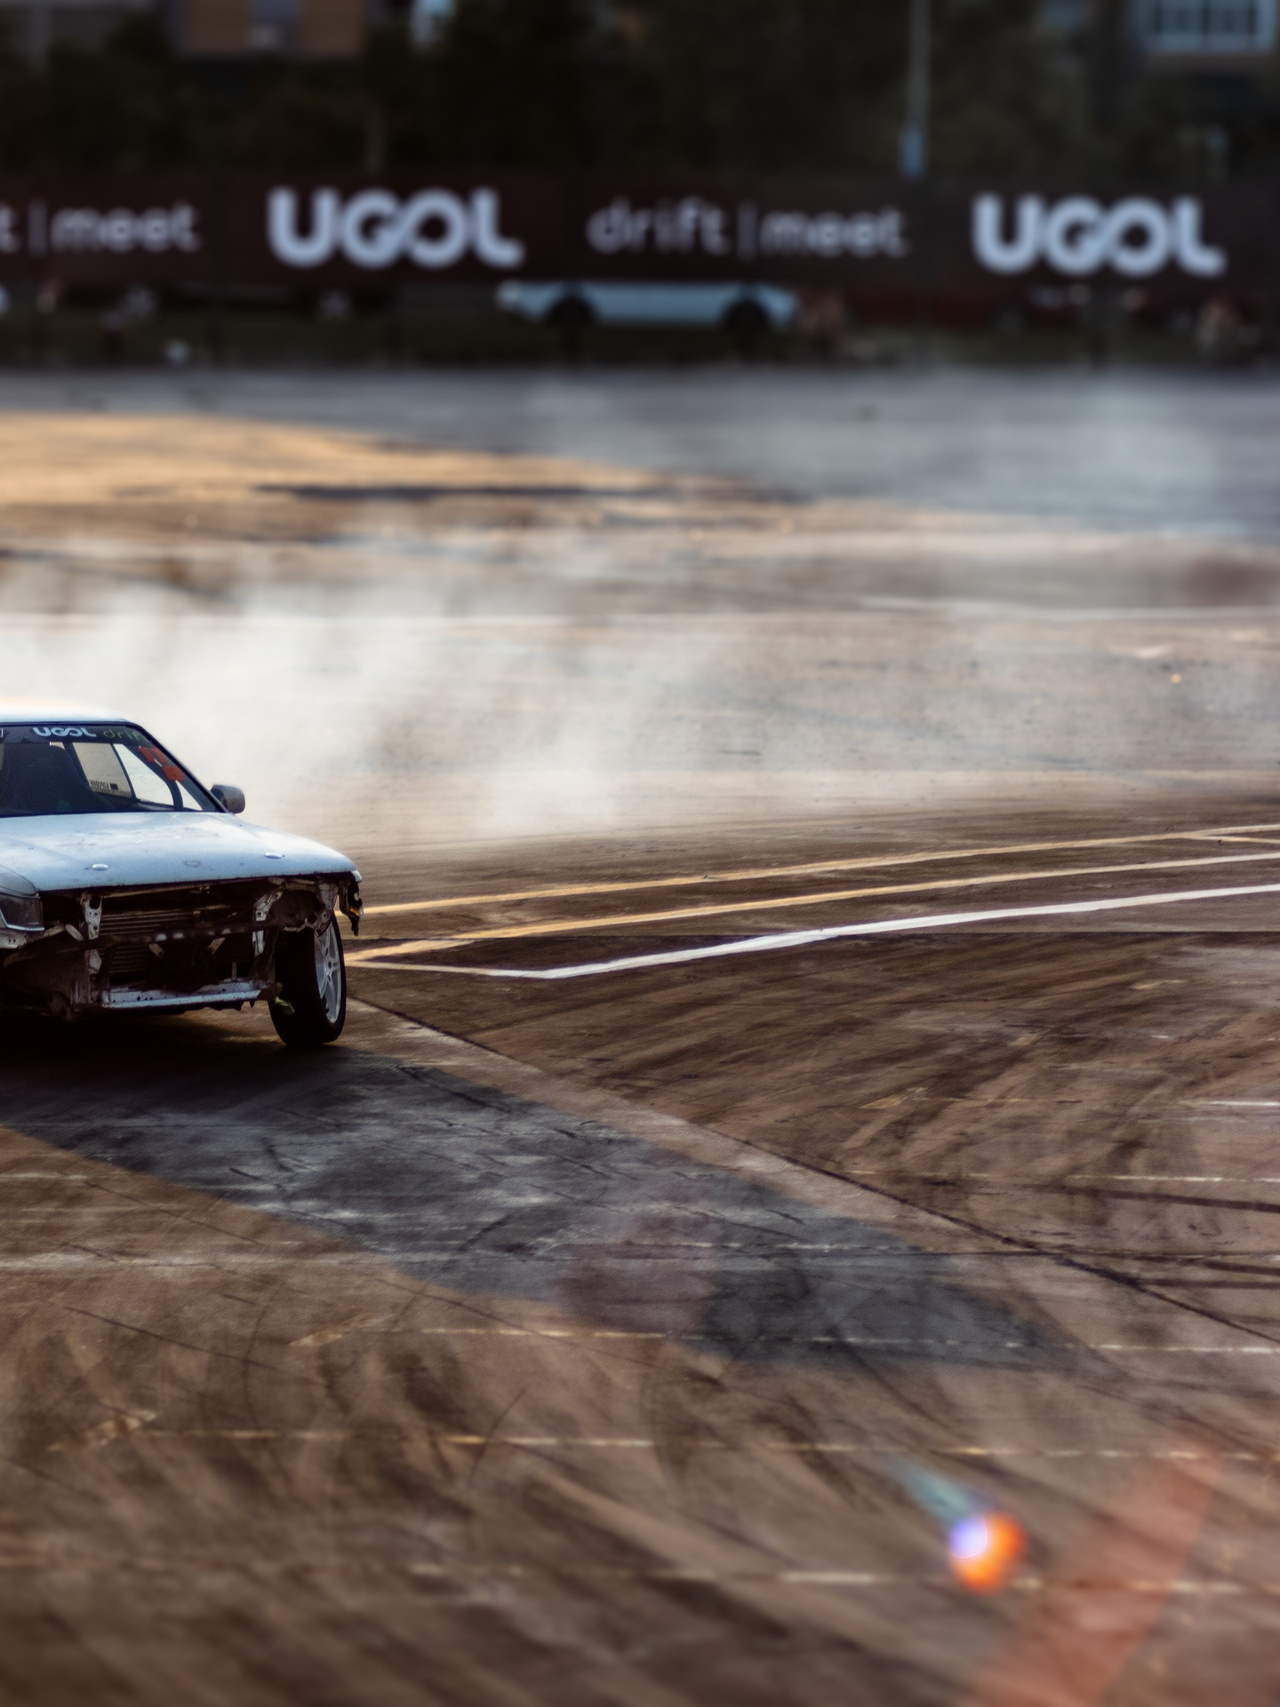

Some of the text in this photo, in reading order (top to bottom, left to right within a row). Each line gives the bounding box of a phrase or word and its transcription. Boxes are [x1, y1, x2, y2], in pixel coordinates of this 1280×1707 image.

[50, 202, 201, 253] meet
[267, 187, 523, 270] UGOL
[586, 197, 908, 257] drift meet
[972, 194, 1227, 276] UGOL
[32, 726, 97, 738] UGOL
